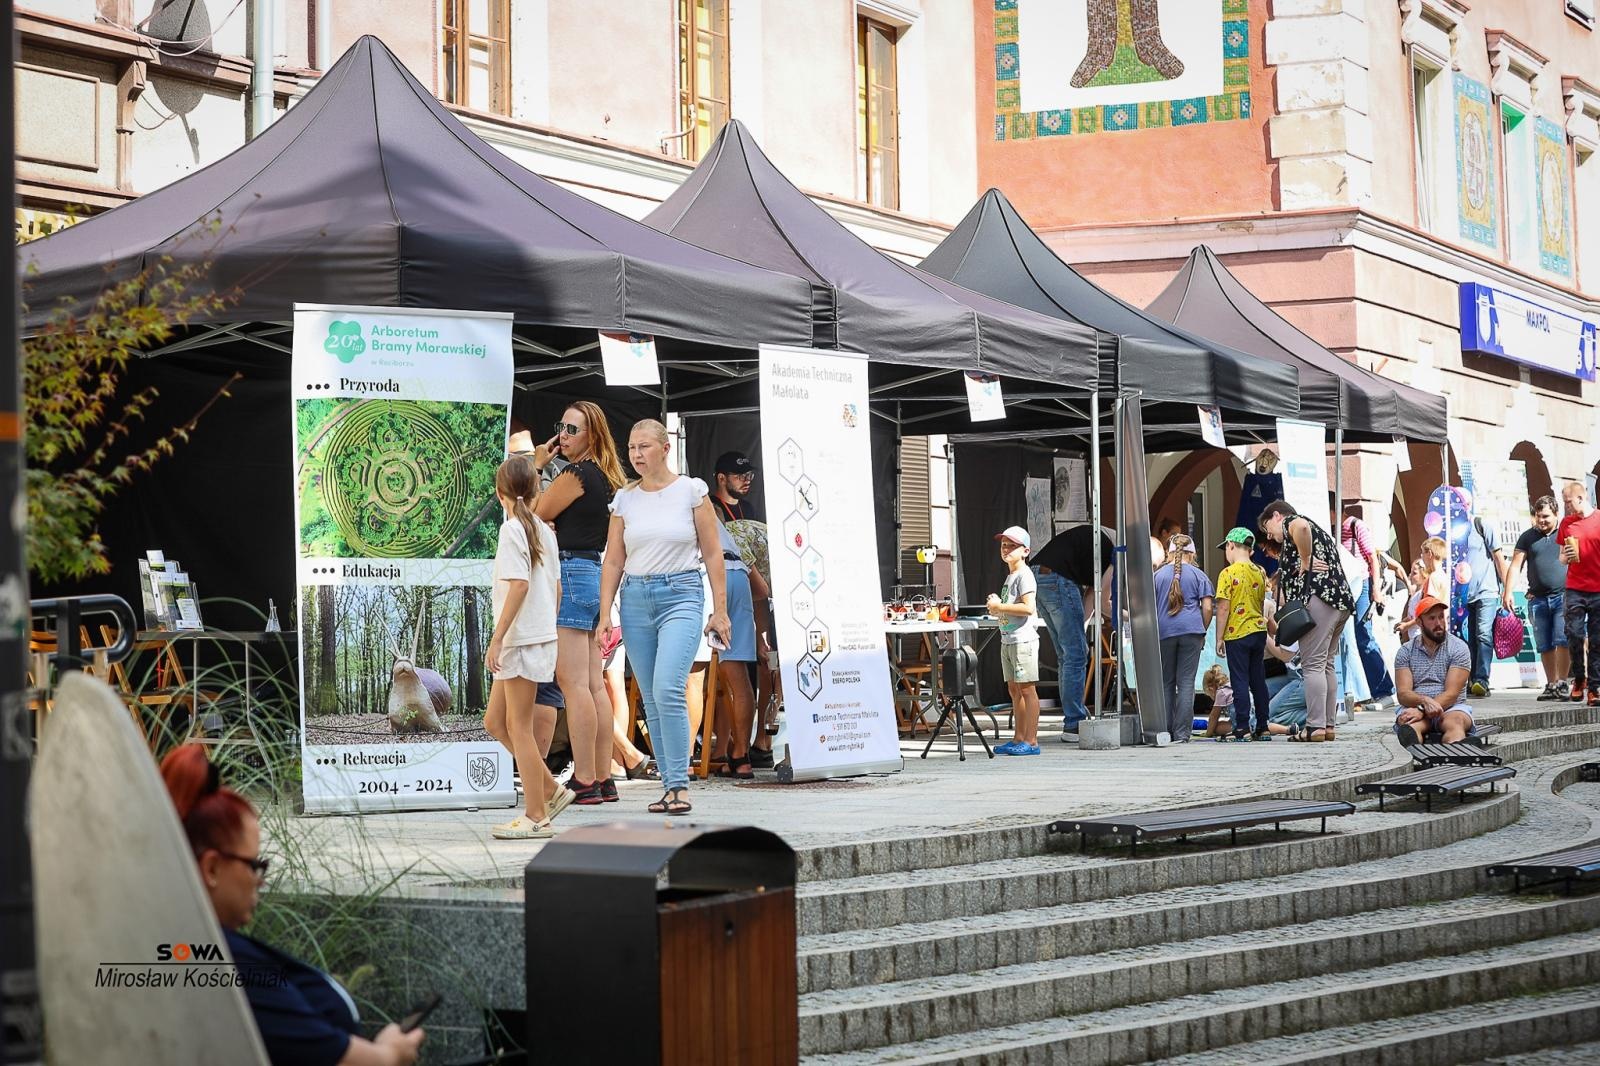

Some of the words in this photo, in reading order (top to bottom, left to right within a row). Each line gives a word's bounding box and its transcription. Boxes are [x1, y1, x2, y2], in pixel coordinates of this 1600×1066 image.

[1526, 309, 1551, 334] MAXPOL
[371, 325, 439, 339] Arboretum
[327, 335, 353, 349] 20
[371, 340, 412, 355] Bramy
[416, 342, 487, 359] Morawskiej
[772, 363, 811, 380] Akademia
[812, 366, 853, 384] Techniczna
[340, 378, 400, 394] Przyroda
[772, 384, 809, 399] Małolata
[342, 564, 401, 580] Edukacja
[343, 751, 406, 767] Rekreacja
[359, 779, 399, 794] 2004
[415, 778, 453, 793] 2024
